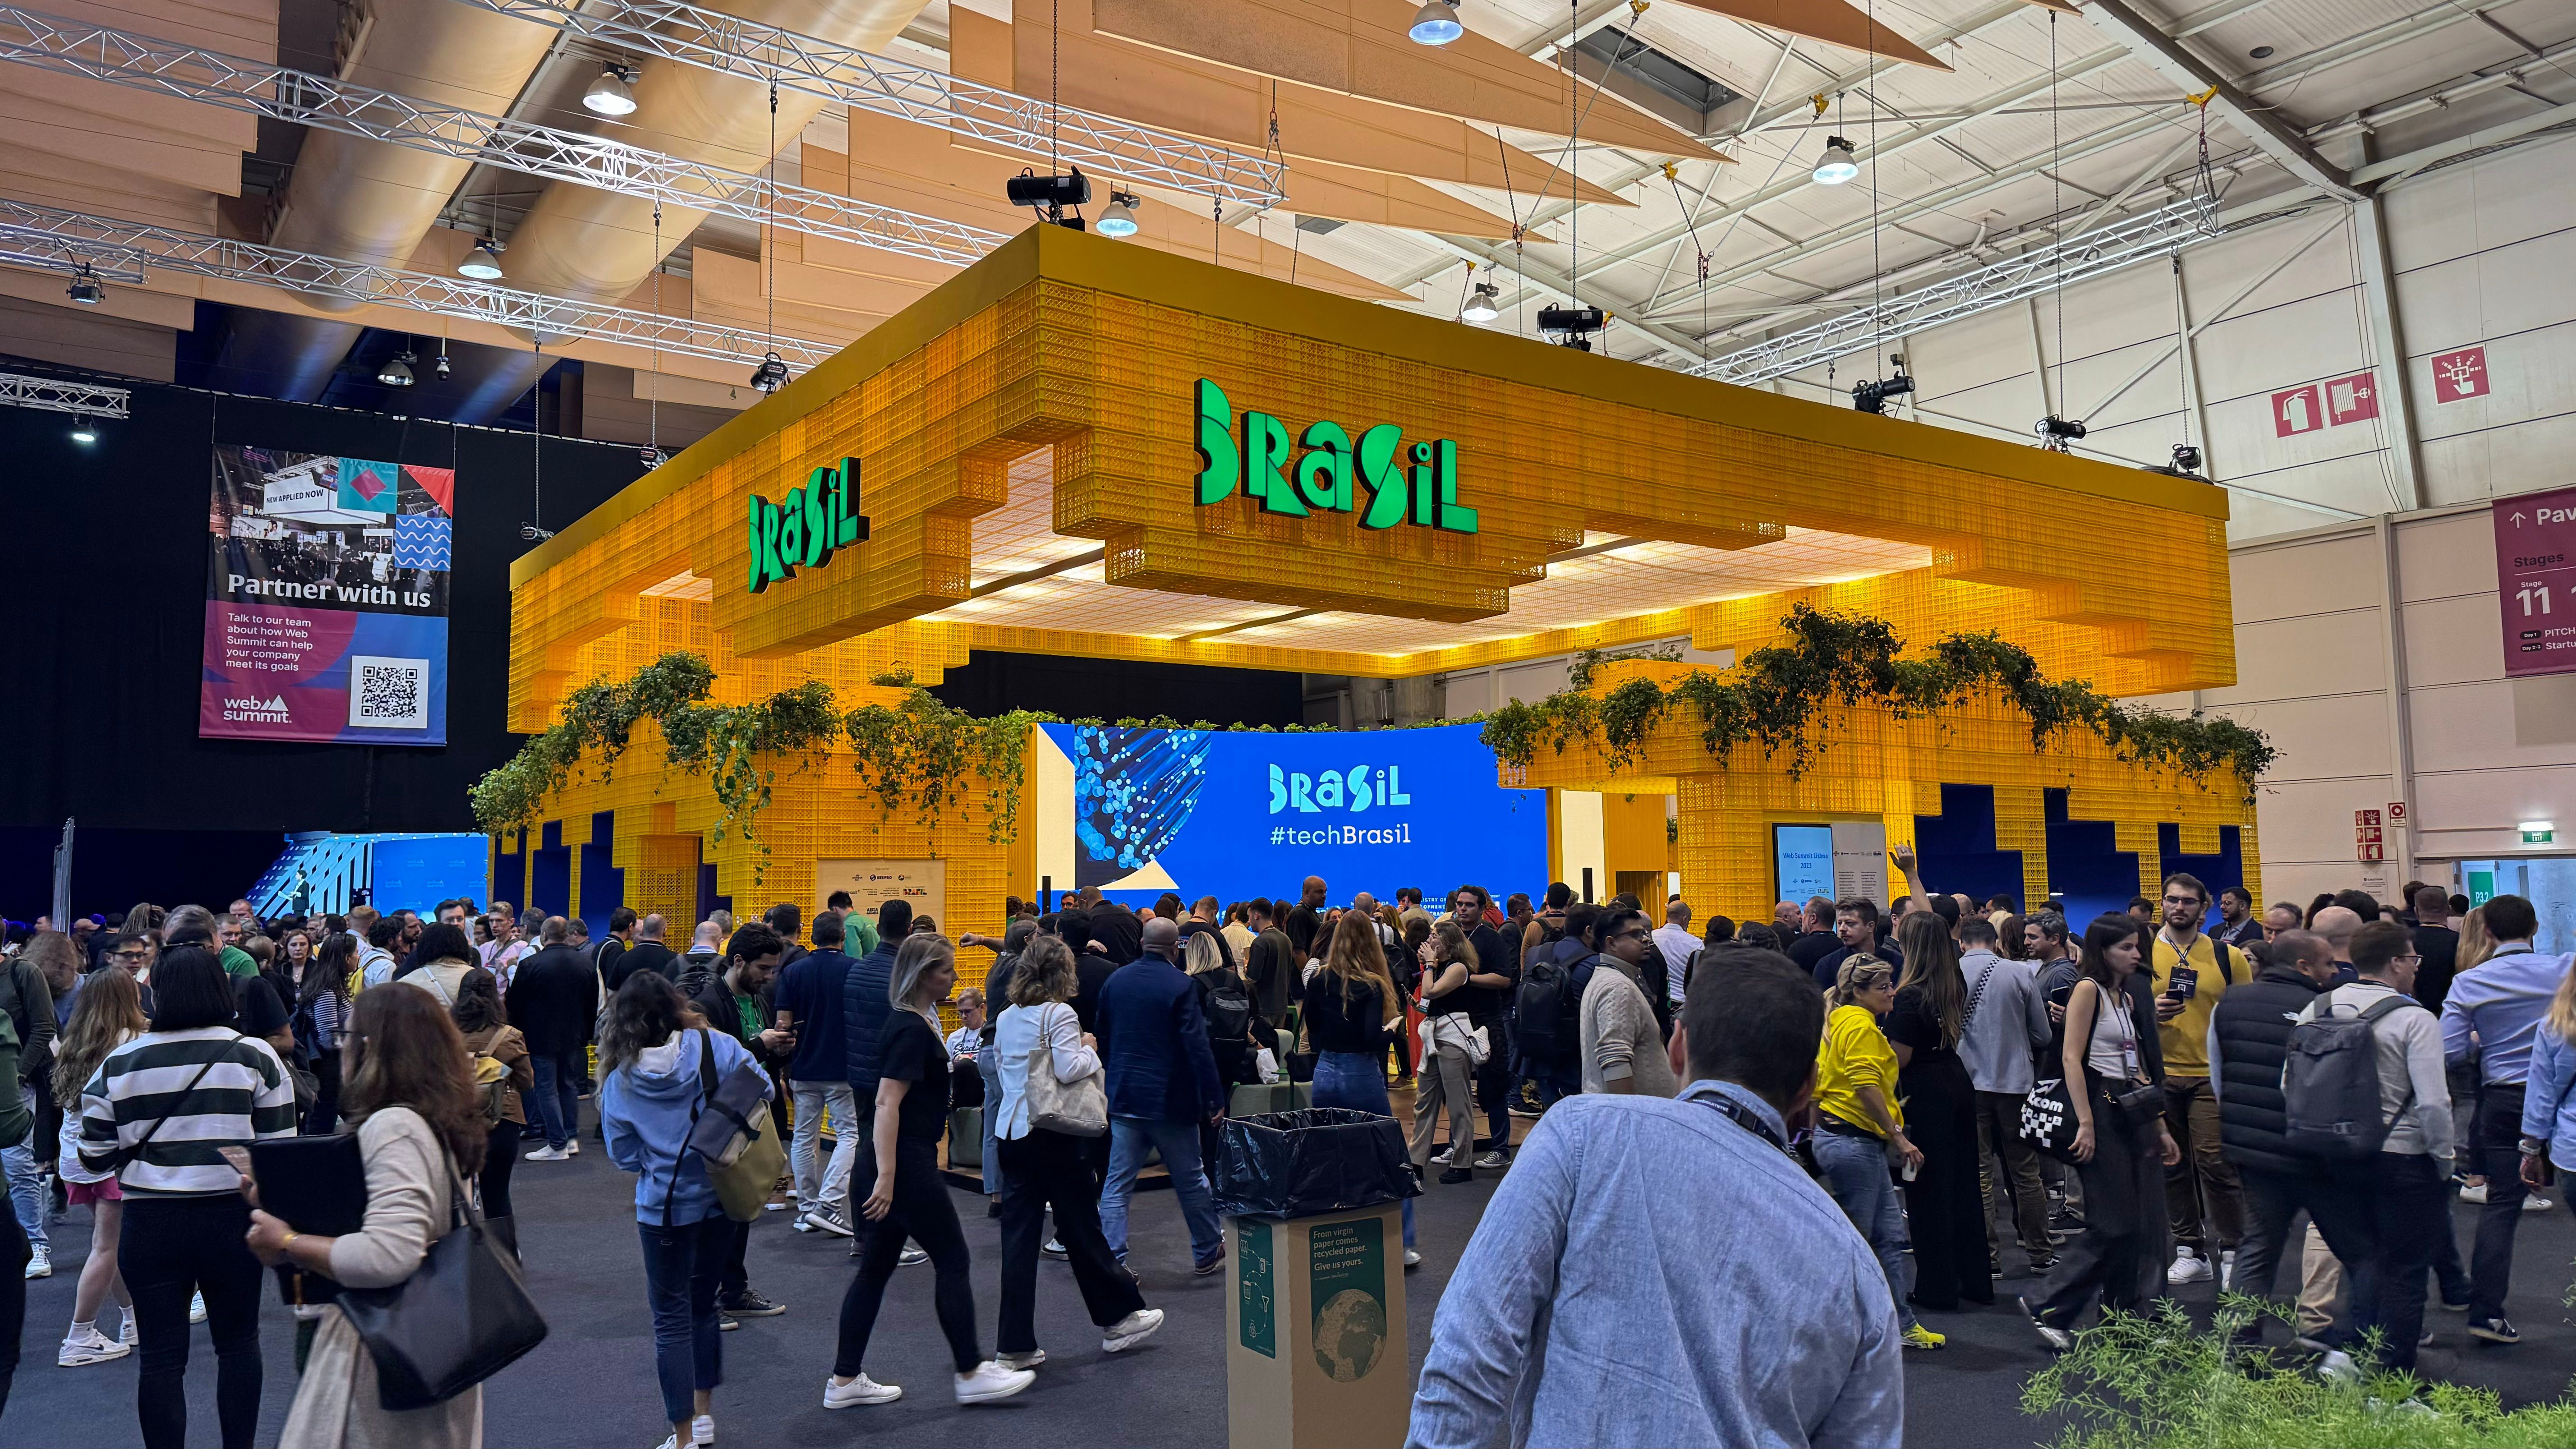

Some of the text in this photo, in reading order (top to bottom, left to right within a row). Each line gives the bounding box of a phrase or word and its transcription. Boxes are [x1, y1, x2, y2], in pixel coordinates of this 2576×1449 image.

[278, 492, 304, 502] APPLIED
[305, 489, 324, 498] NOW
[2514, 554, 2564, 567] Stages
[228, 574, 430, 607] Partner with us
[2516, 586, 2550, 616] 11
[228, 613, 249, 622] Talk
[253, 615, 262, 623] to
[285, 618, 311, 627] team
[227, 625, 308, 638] about how Web
[2544, 627, 2576, 637] PITCH
[227, 636, 267, 647] Summit
[291, 640, 313, 651] help
[226, 649, 300, 661] your company
[226, 660, 299, 672] meet its goals
[224, 695, 261, 710] web
[1270, 823, 1411, 845] #techBrasil
[1313, 1226, 1353, 1239] From virgin
[1314, 1237, 1358, 1250] paper comes
[1314, 1245, 1367, 1258] recycled paper.
[1314, 1263, 1330, 1271] Give
[1342, 1259, 1363, 1268] yours.
